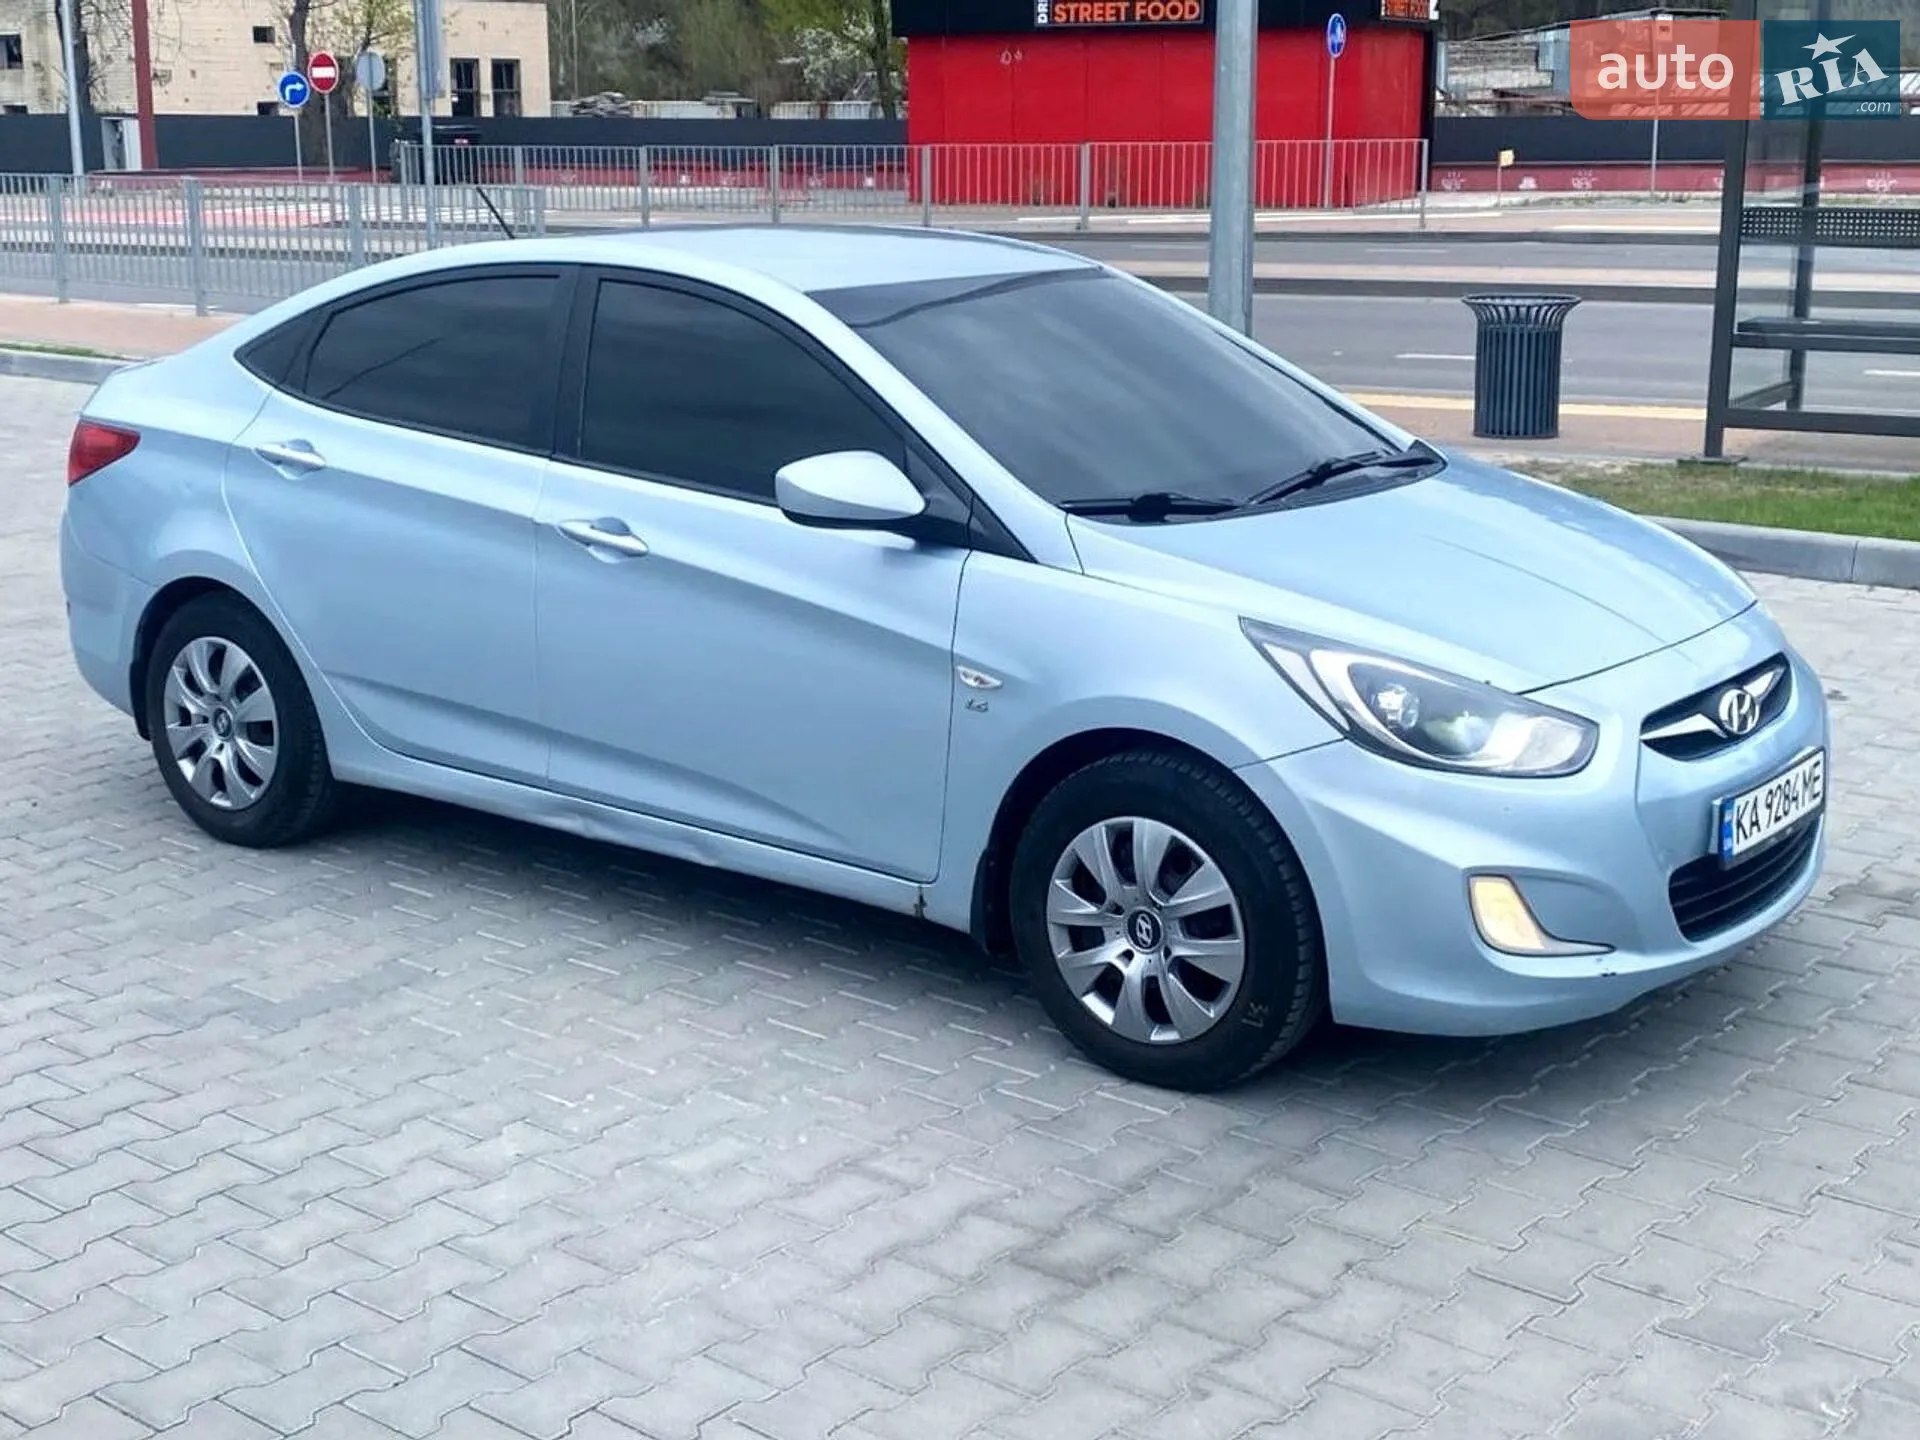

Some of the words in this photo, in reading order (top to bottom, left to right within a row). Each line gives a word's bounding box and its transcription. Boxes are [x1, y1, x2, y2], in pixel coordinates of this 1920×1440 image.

[1054, 2, 1129, 23] STREET
[1135, 1, 1200, 21] FOOD
[1736, 796, 1761, 846] KA
[1765, 773, 1799, 829] 9284
[1802, 761, 1820, 807] ME
